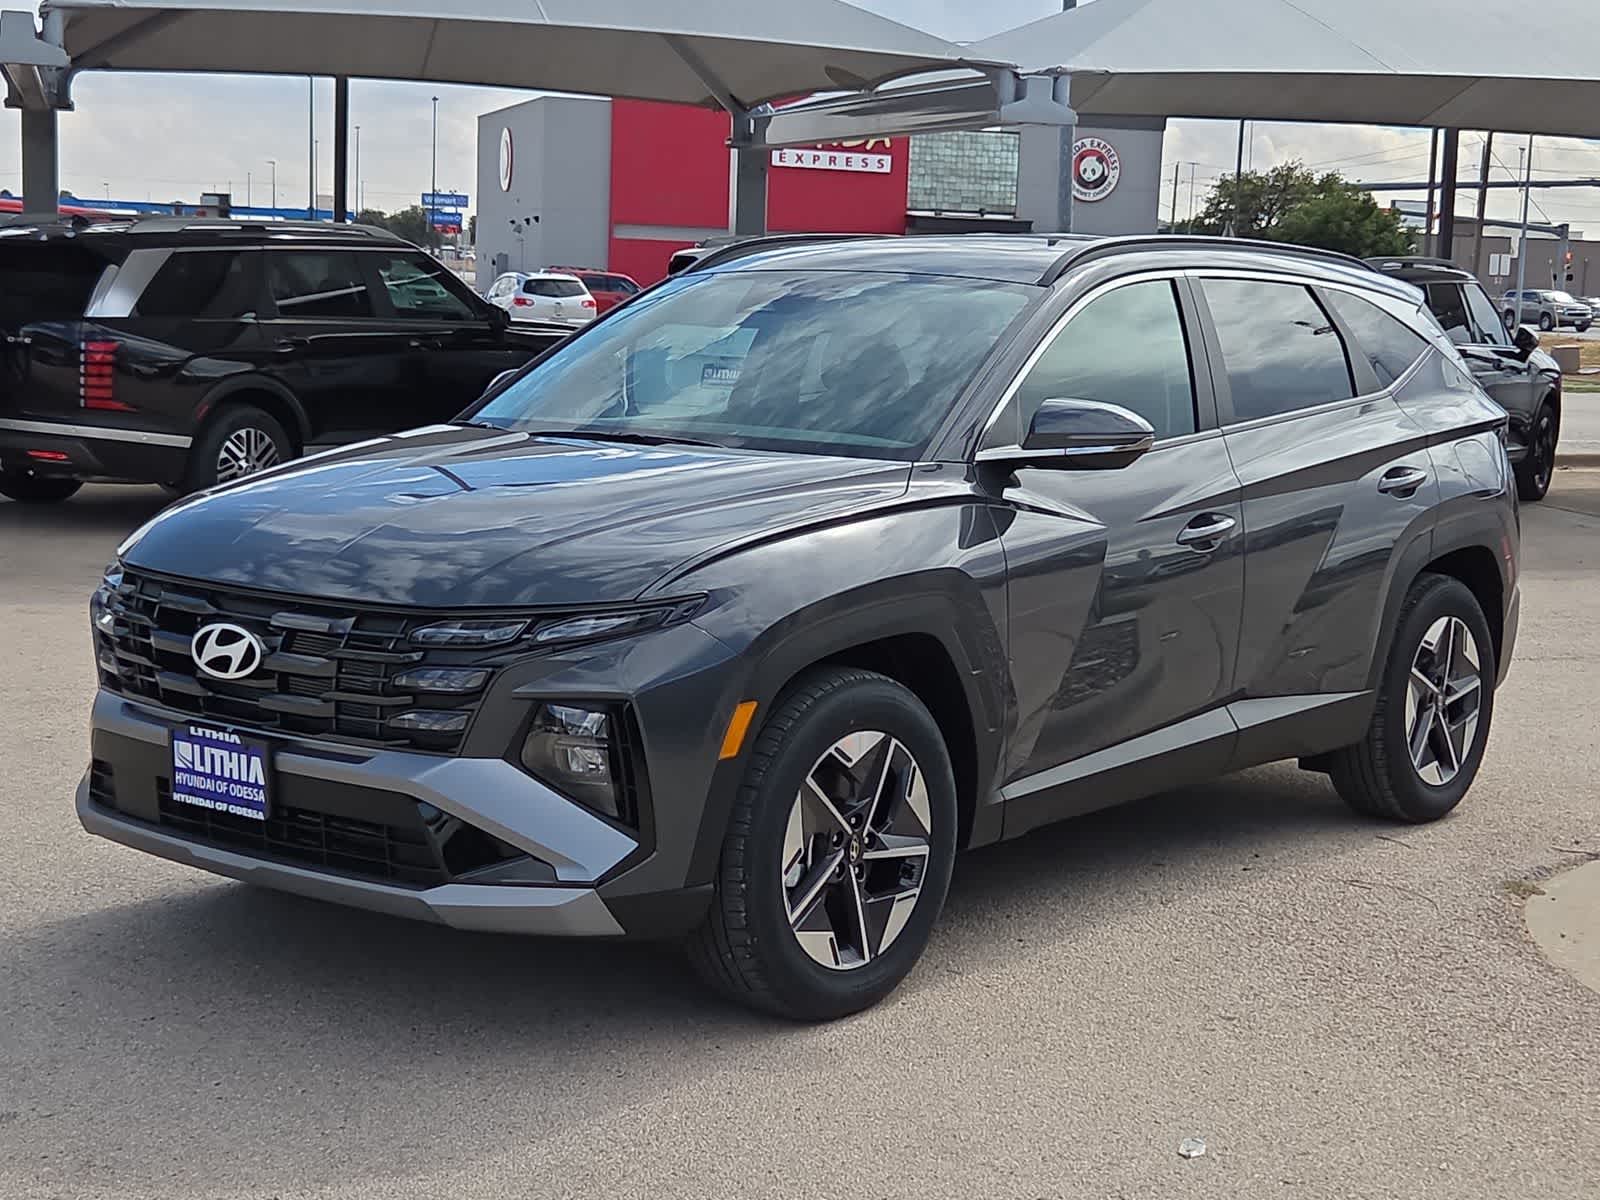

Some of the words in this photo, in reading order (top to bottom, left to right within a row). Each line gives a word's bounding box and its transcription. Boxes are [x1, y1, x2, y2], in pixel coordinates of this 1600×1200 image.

[779, 152, 885, 169] EXPRESS
[189, 726, 241, 744] LITHIA
[193, 744, 265, 785] LITHIA
[175, 772, 215, 791] HYUNDAI
[216, 780, 228, 794] OF
[229, 783, 265, 803] ODESSA
[173, 792, 215, 809] HYUNDAI
[215, 801, 228, 812] OF
[228, 804, 264, 820] ODESSA
